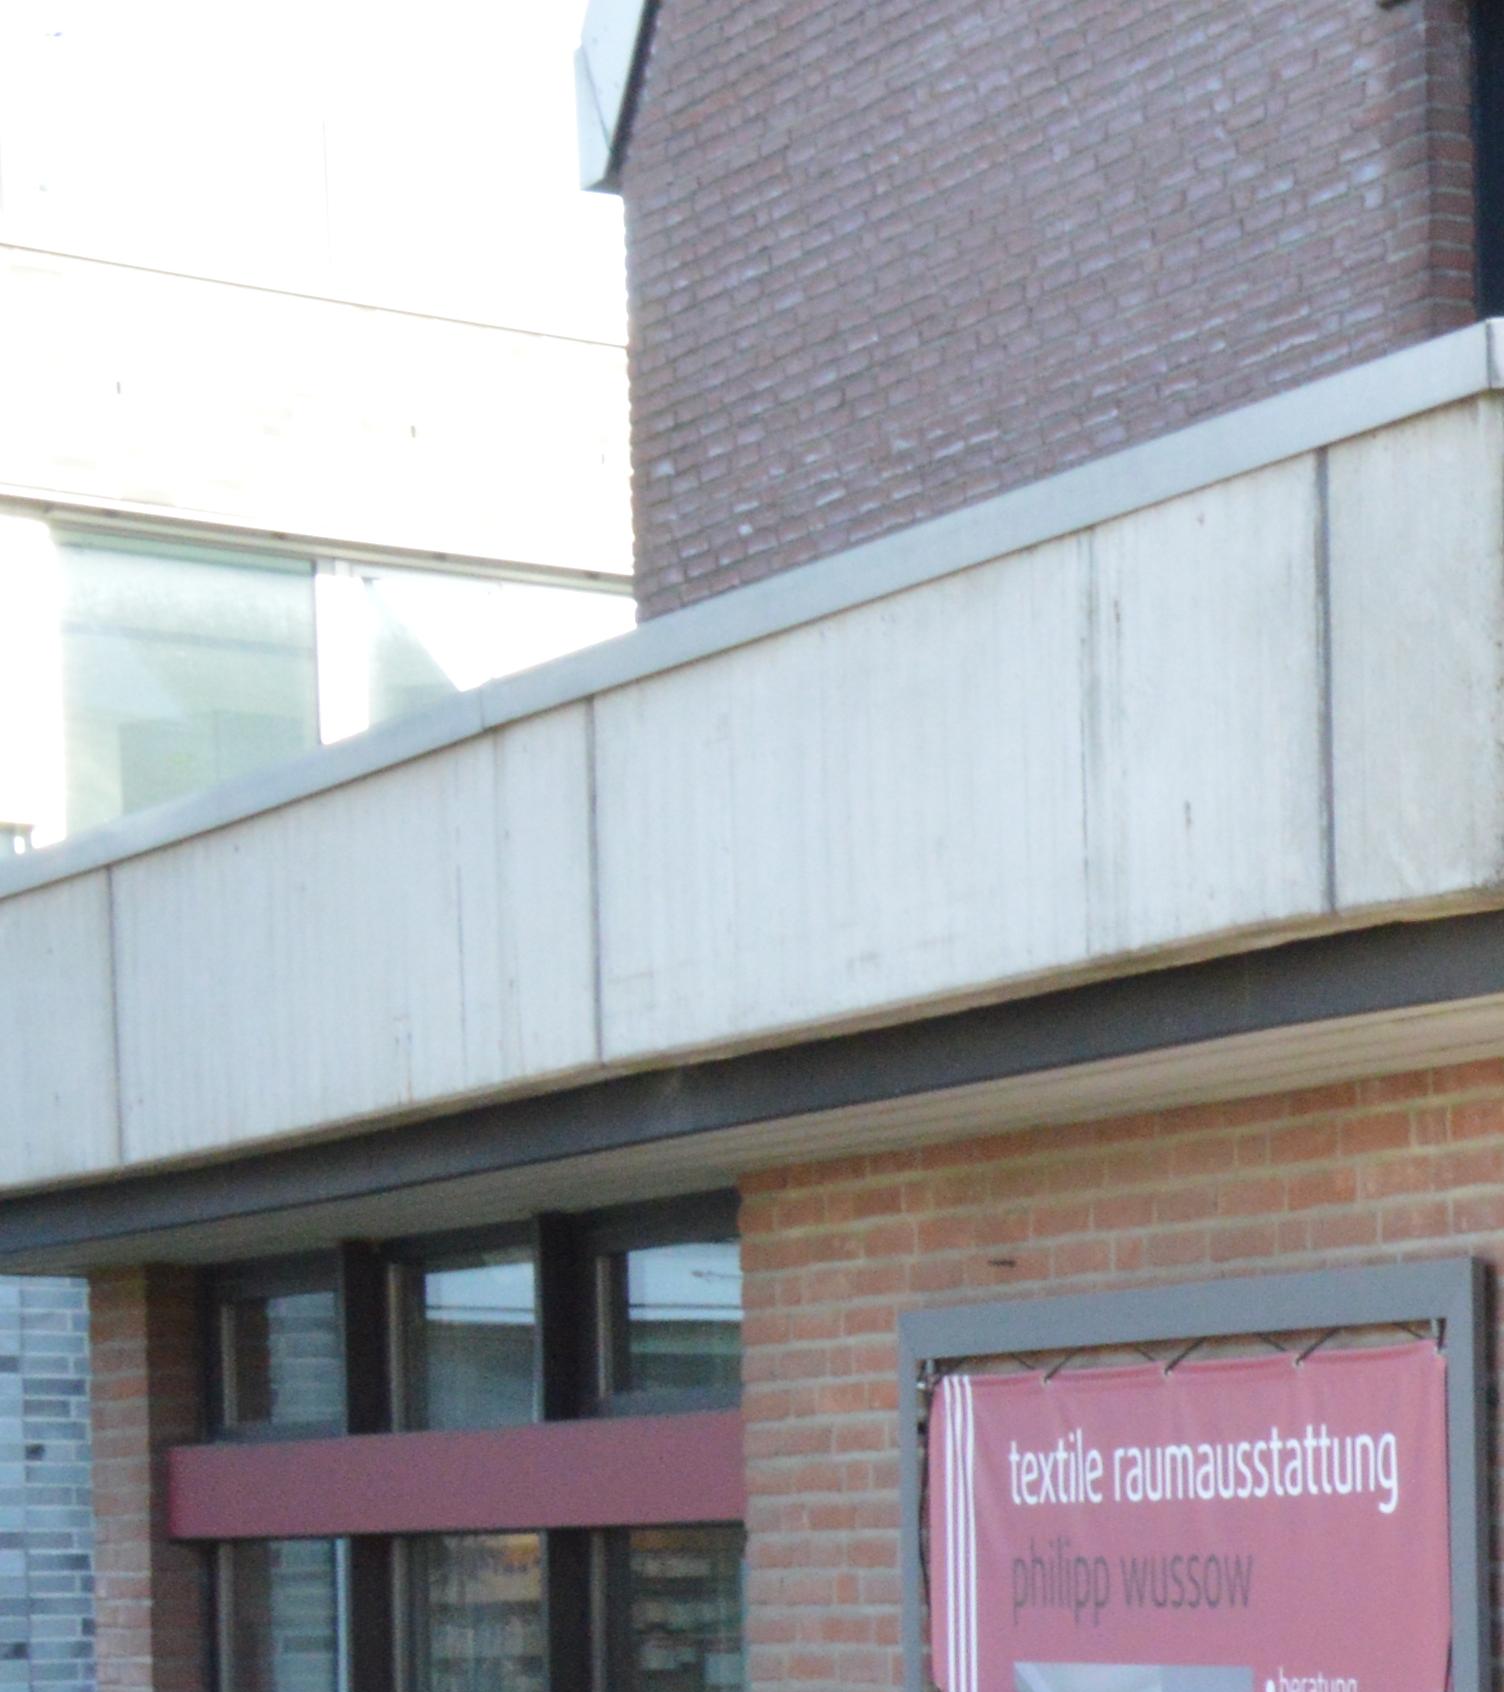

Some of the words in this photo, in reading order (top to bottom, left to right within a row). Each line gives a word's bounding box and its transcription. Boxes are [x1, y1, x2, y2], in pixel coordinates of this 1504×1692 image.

[1009, 1428, 1103, 1506] textile
[1113, 1423, 1400, 1515] raumausstattung
[1011, 1536, 1111, 1629] philipp
[1121, 1552, 1255, 1611] wussow
